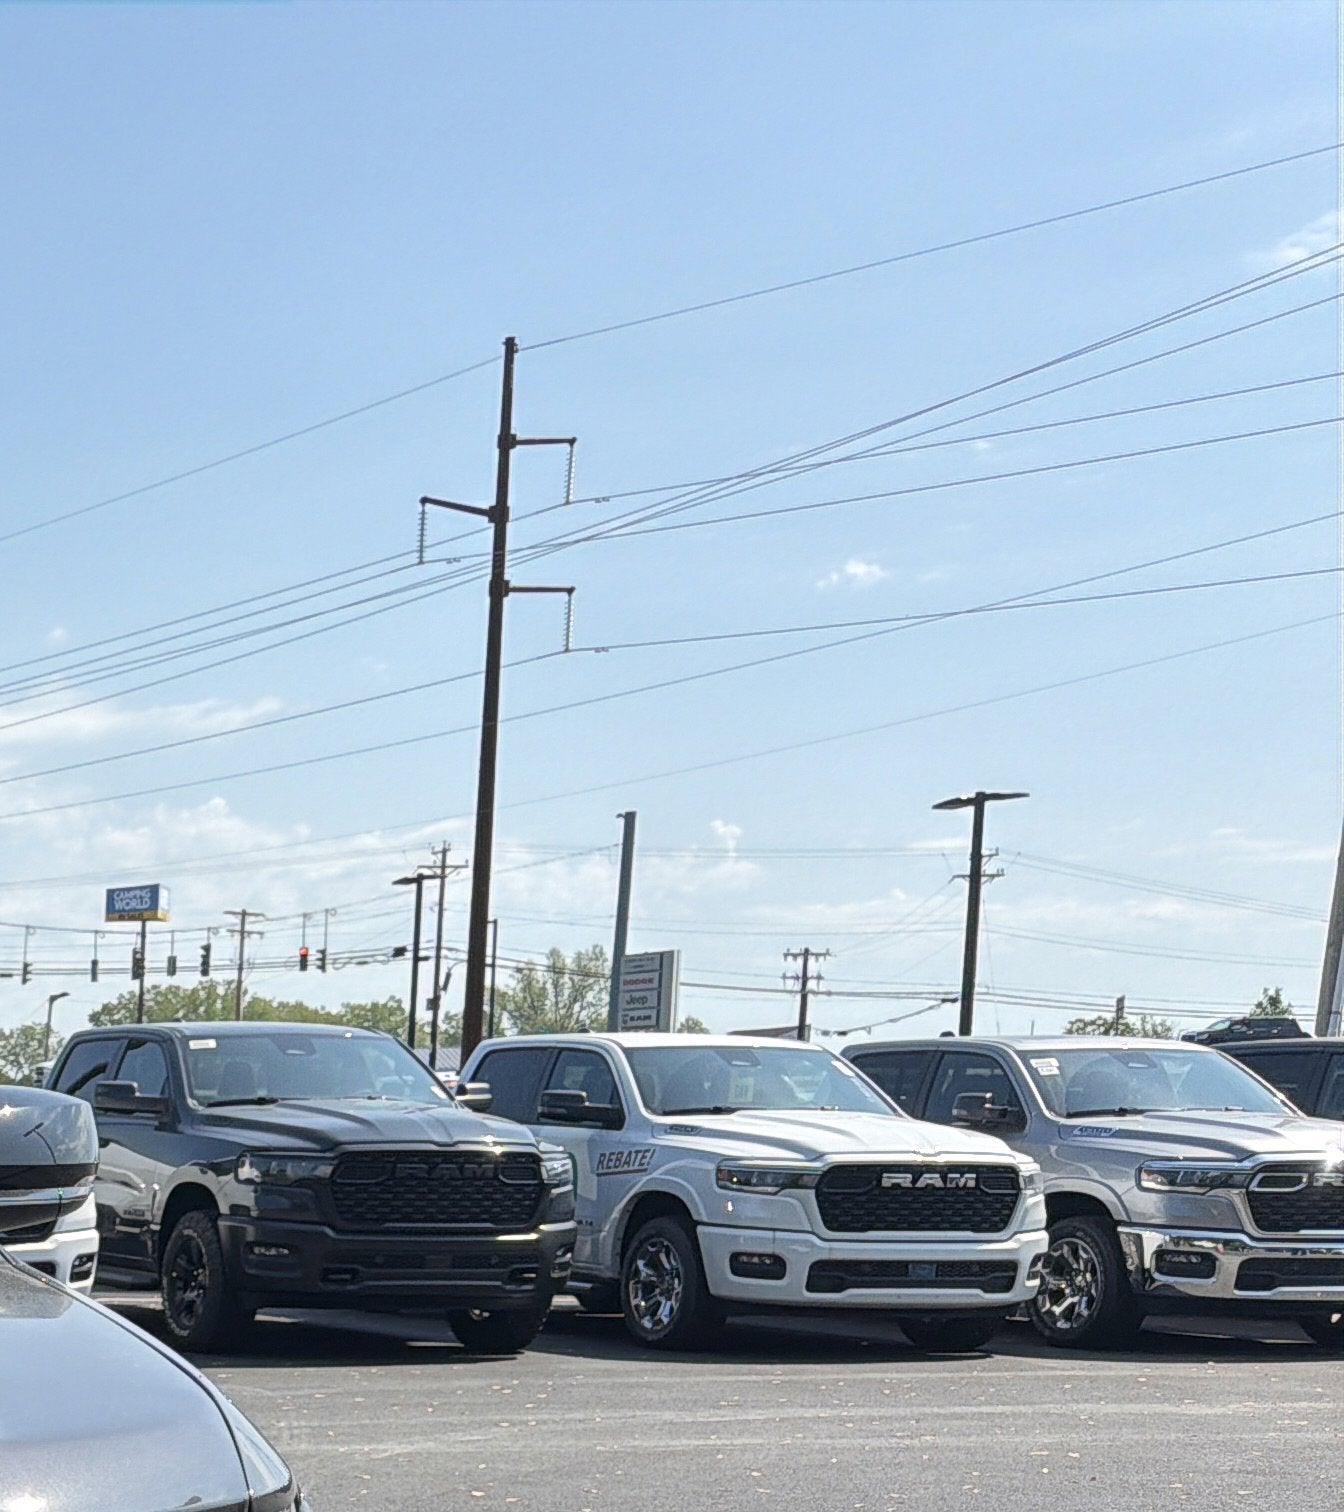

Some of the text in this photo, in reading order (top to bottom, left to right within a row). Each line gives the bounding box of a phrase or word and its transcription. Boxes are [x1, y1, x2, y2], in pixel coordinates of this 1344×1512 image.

[113, 889, 151, 899] CAMPING
[114, 898, 151, 910] WORLD
[625, 994, 648, 1005] Jeep
[596, 1148, 656, 1171] REBATE!
[395, 1163, 495, 1178] RAM
[881, 1173, 977, 1188] RAM
